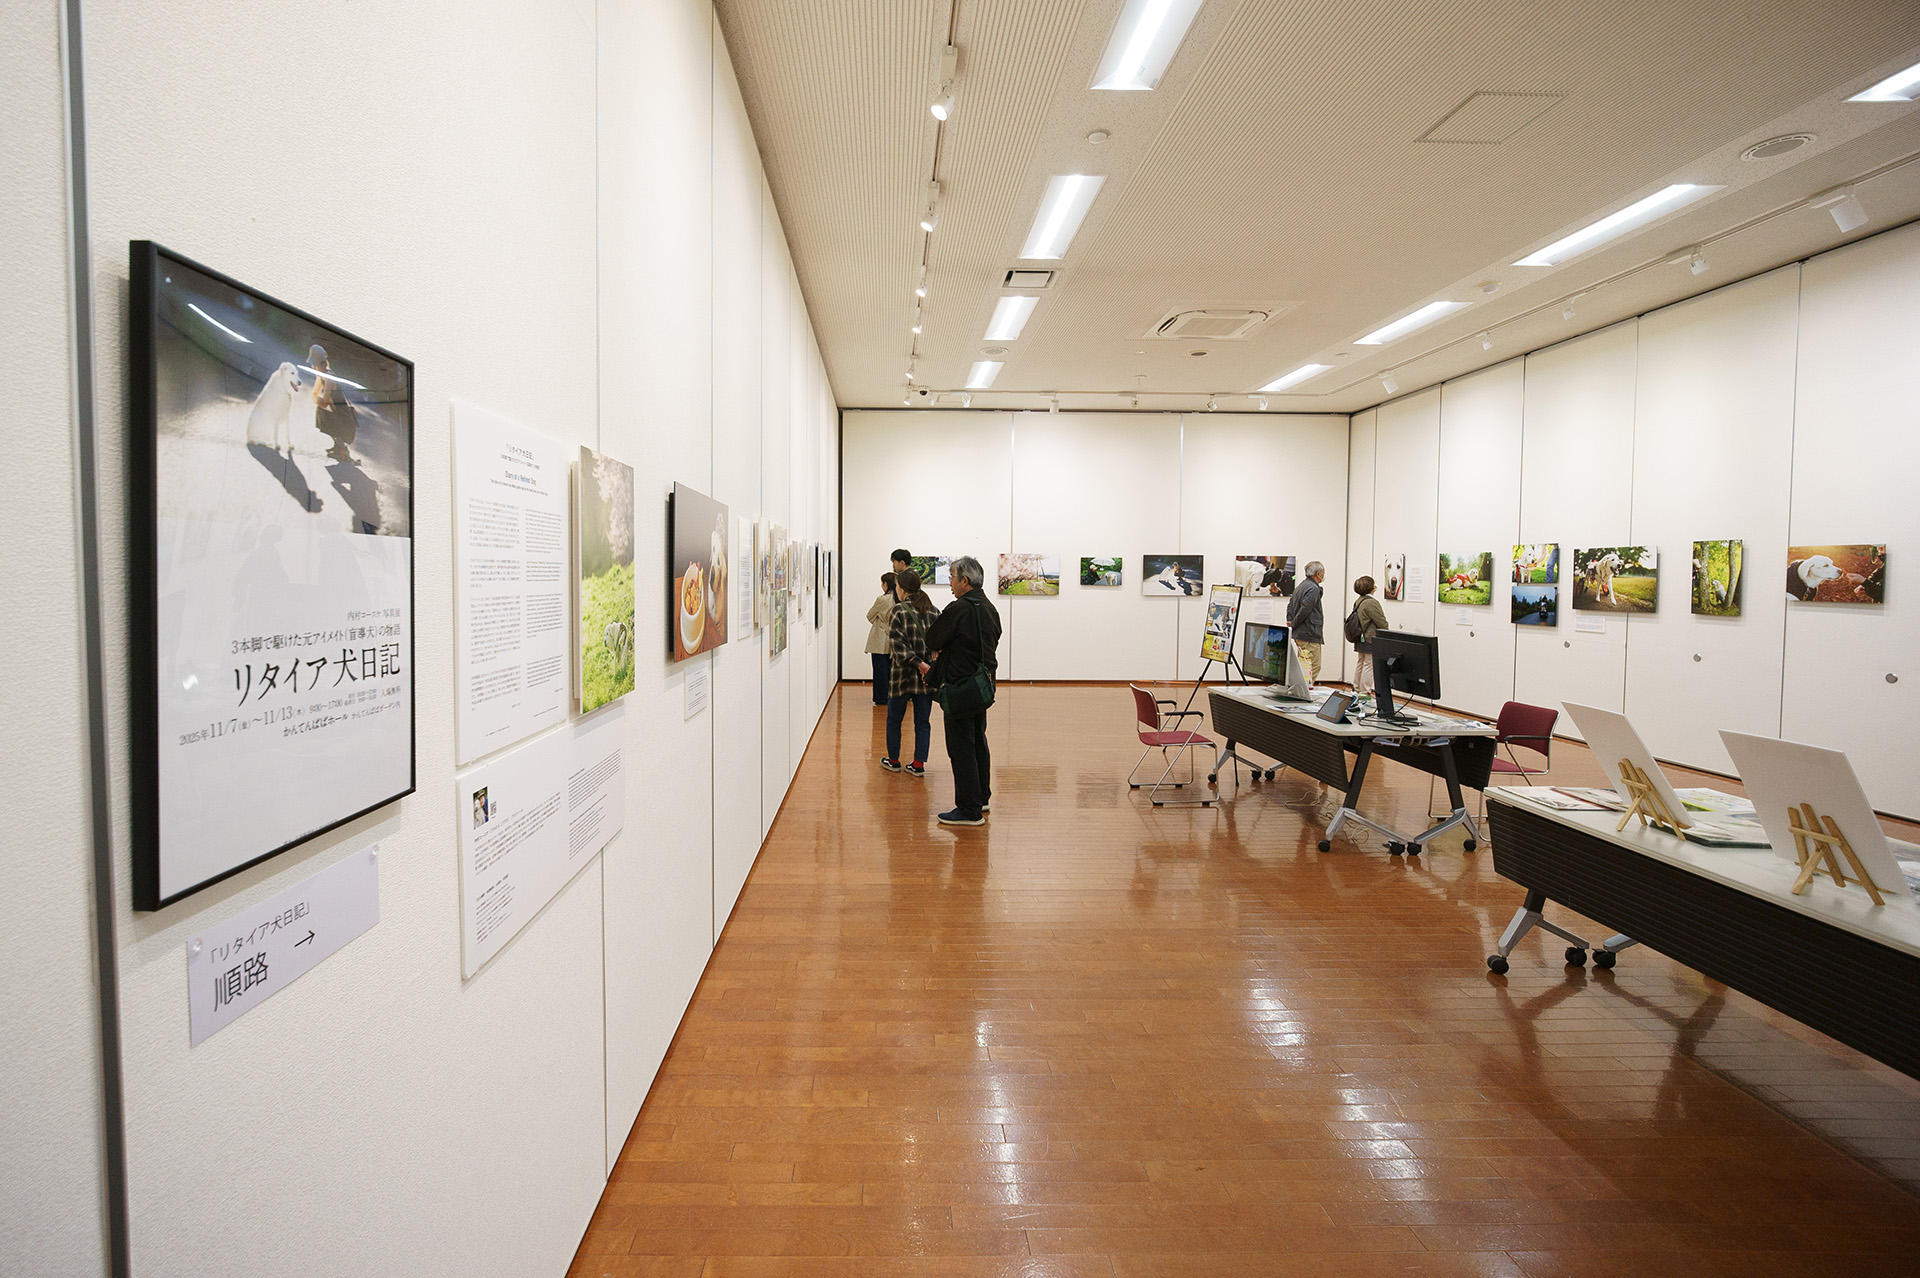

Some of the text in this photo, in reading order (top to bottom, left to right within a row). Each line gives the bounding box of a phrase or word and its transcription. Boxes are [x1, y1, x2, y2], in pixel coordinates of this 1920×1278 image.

[234, 643, 401, 707] リタイア犬日記
[210, 901, 310, 964] 「リタイア犬日記」
[214, 951, 269, 1012] 順路
